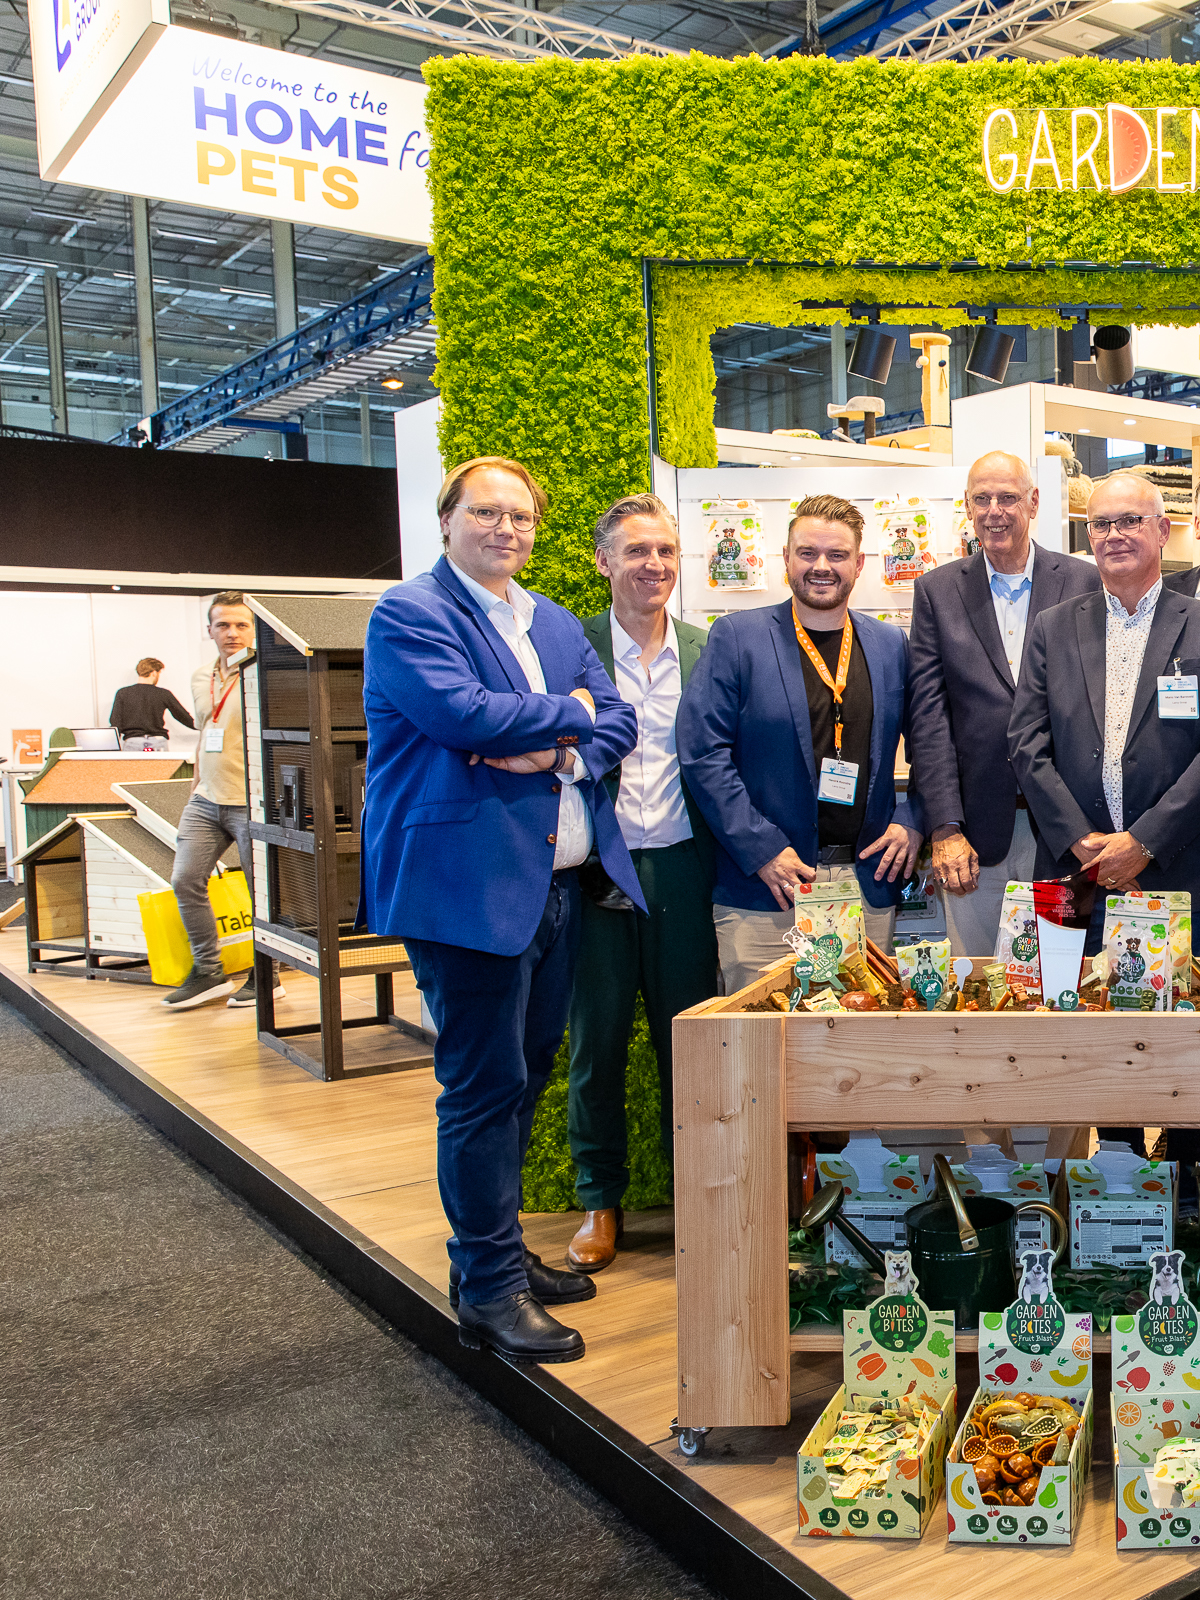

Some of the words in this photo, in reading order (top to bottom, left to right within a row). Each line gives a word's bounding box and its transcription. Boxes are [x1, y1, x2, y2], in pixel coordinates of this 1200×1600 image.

[192, 53, 303, 97] Welcome
[313, 82, 338, 104] to
[349, 89, 389, 117] the
[193, 86, 389, 167] HOME
[399, 130, 429, 171] fo
[196, 141, 360, 210] PETS
[819, 937, 840, 947] GARDEN
[878, 1304, 920, 1319] GARDEN
[1016, 1304, 1058, 1320] GARDEN
[1148, 1304, 1190, 1321] GARDEN
[883, 1318, 914, 1333] BITES
[1020, 1319, 1051, 1334] BITES
[1152, 1320, 1184, 1336] BITES
[1018, 1334, 1035, 1343] Fruit
[1036, 1334, 1054, 1342] Blast
[1151, 1335, 1168, 1344] Fruit
[1168, 1334, 1187, 1343] Blast
